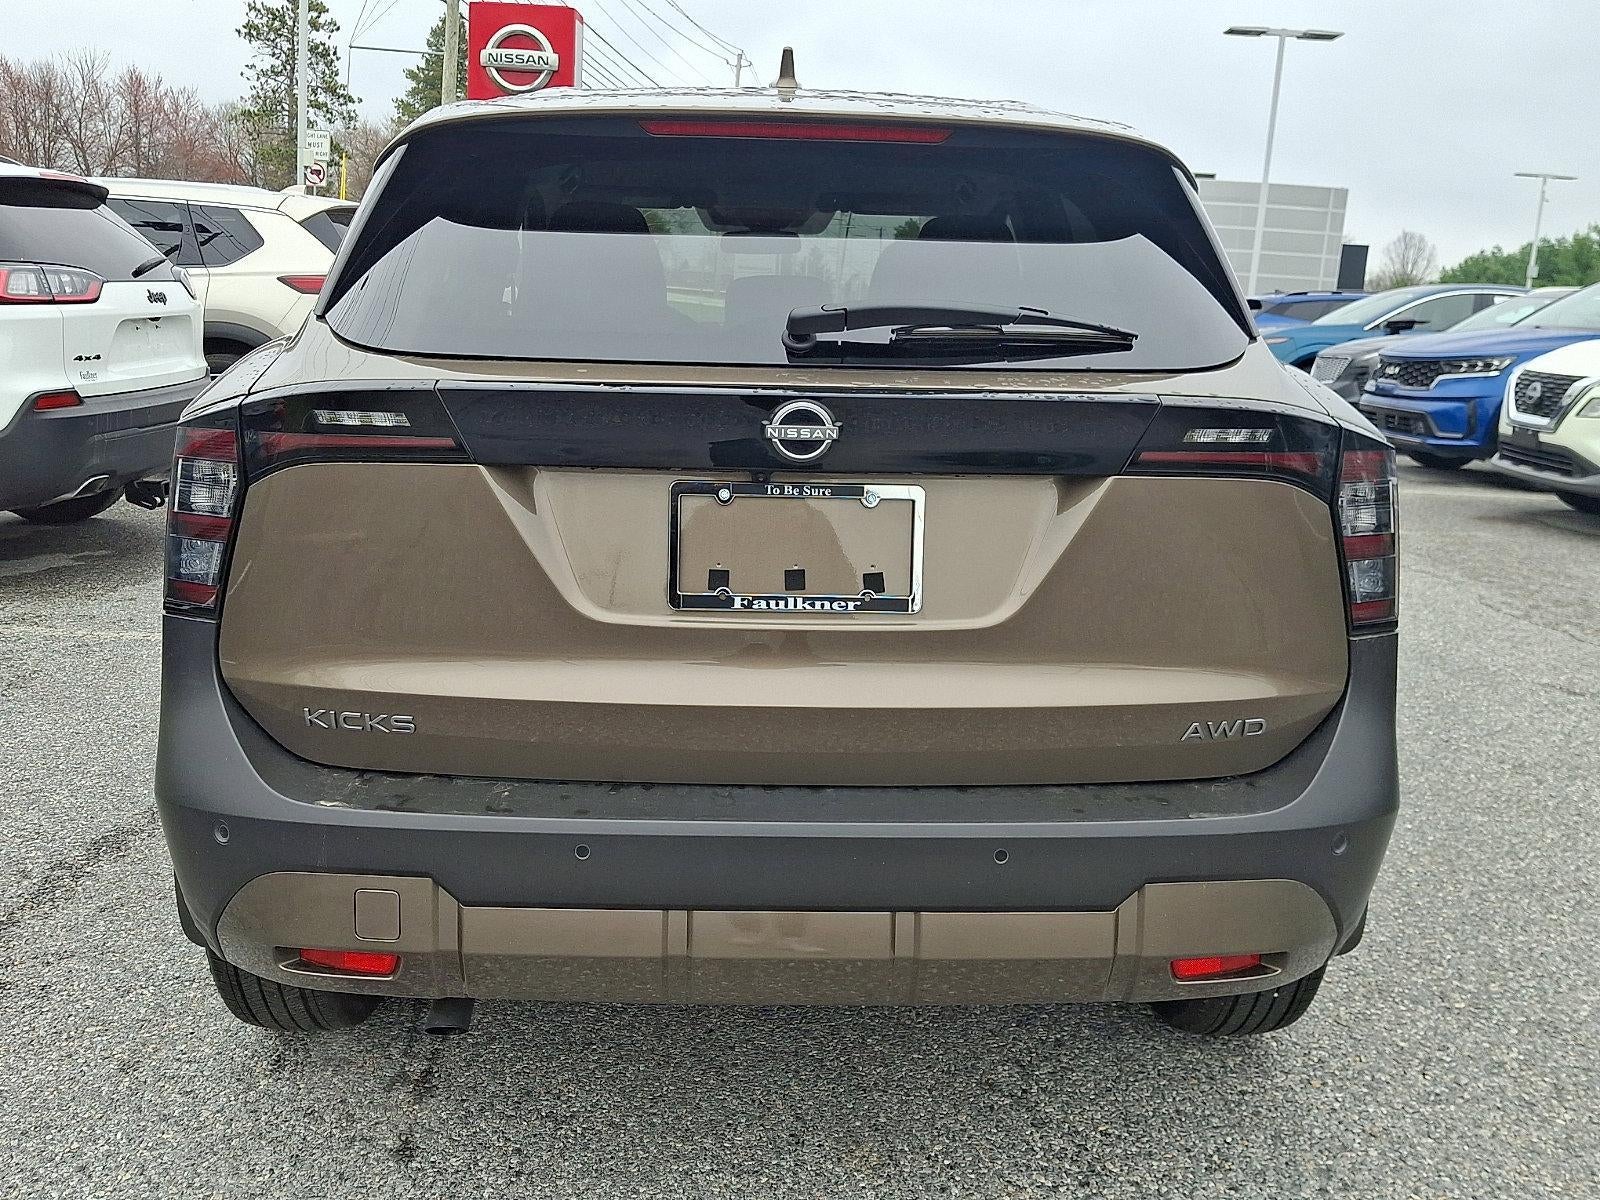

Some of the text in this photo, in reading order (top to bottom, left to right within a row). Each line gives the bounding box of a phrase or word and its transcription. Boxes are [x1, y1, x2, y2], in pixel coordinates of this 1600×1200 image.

[487, 52, 549, 66] NISSAN
[147, 289, 167, 305] Jeep
[767, 428, 837, 439] NISSAN
[765, 485, 832, 496] To Be Sure
[731, 596, 861, 611] Faulkner
[303, 707, 416, 734] KICKS
[1180, 718, 1267, 742] AWD
